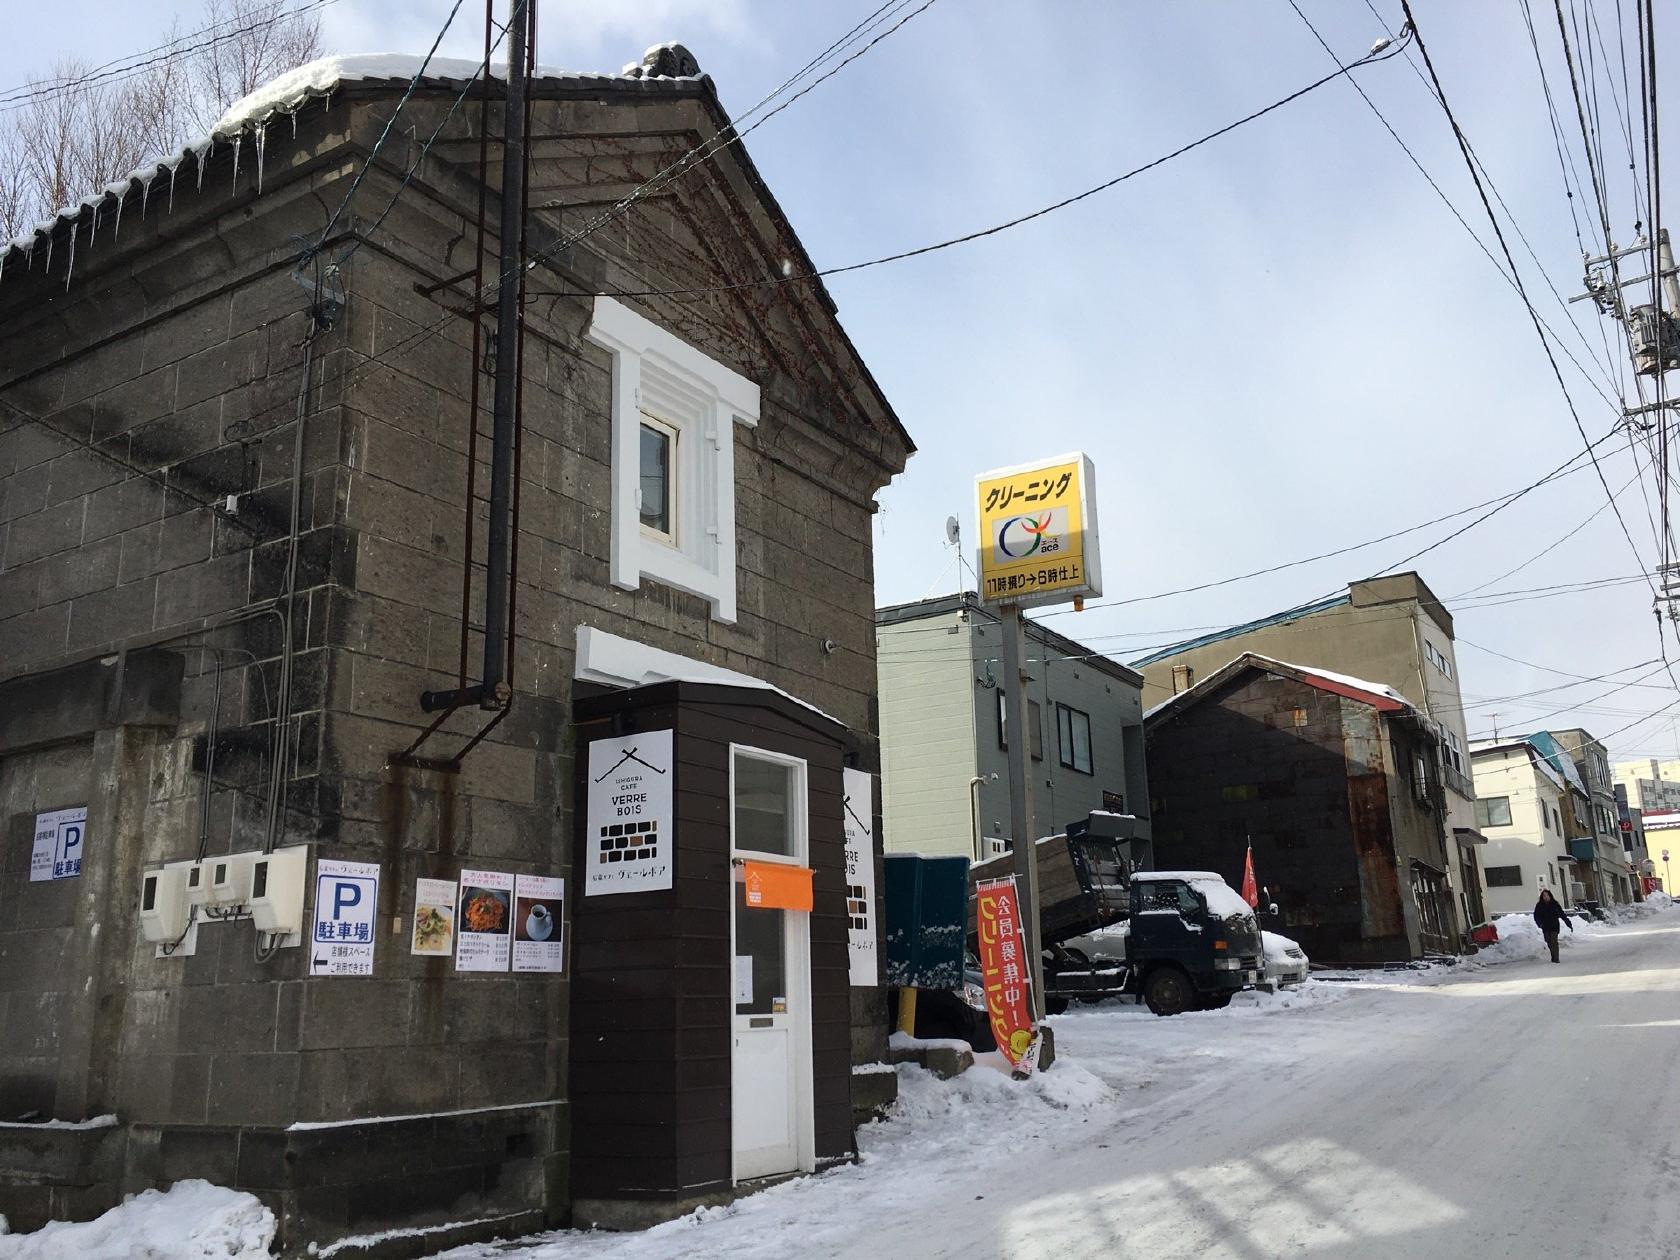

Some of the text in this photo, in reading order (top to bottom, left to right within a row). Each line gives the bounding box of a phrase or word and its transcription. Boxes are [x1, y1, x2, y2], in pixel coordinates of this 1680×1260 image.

[985, 472, 1072, 513] クリーニング
[1041, 543, 1059, 553] ace
[620, 783, 638, 791] CAFE
[612, 792, 647, 806] VERRE
[617, 804, 642, 817] BOIS
[64, 826, 80, 859] P
[333, 882, 361, 920] P
[318, 921, 369, 941] 駐車場
[330, 961, 370, 975] ご利用できます
